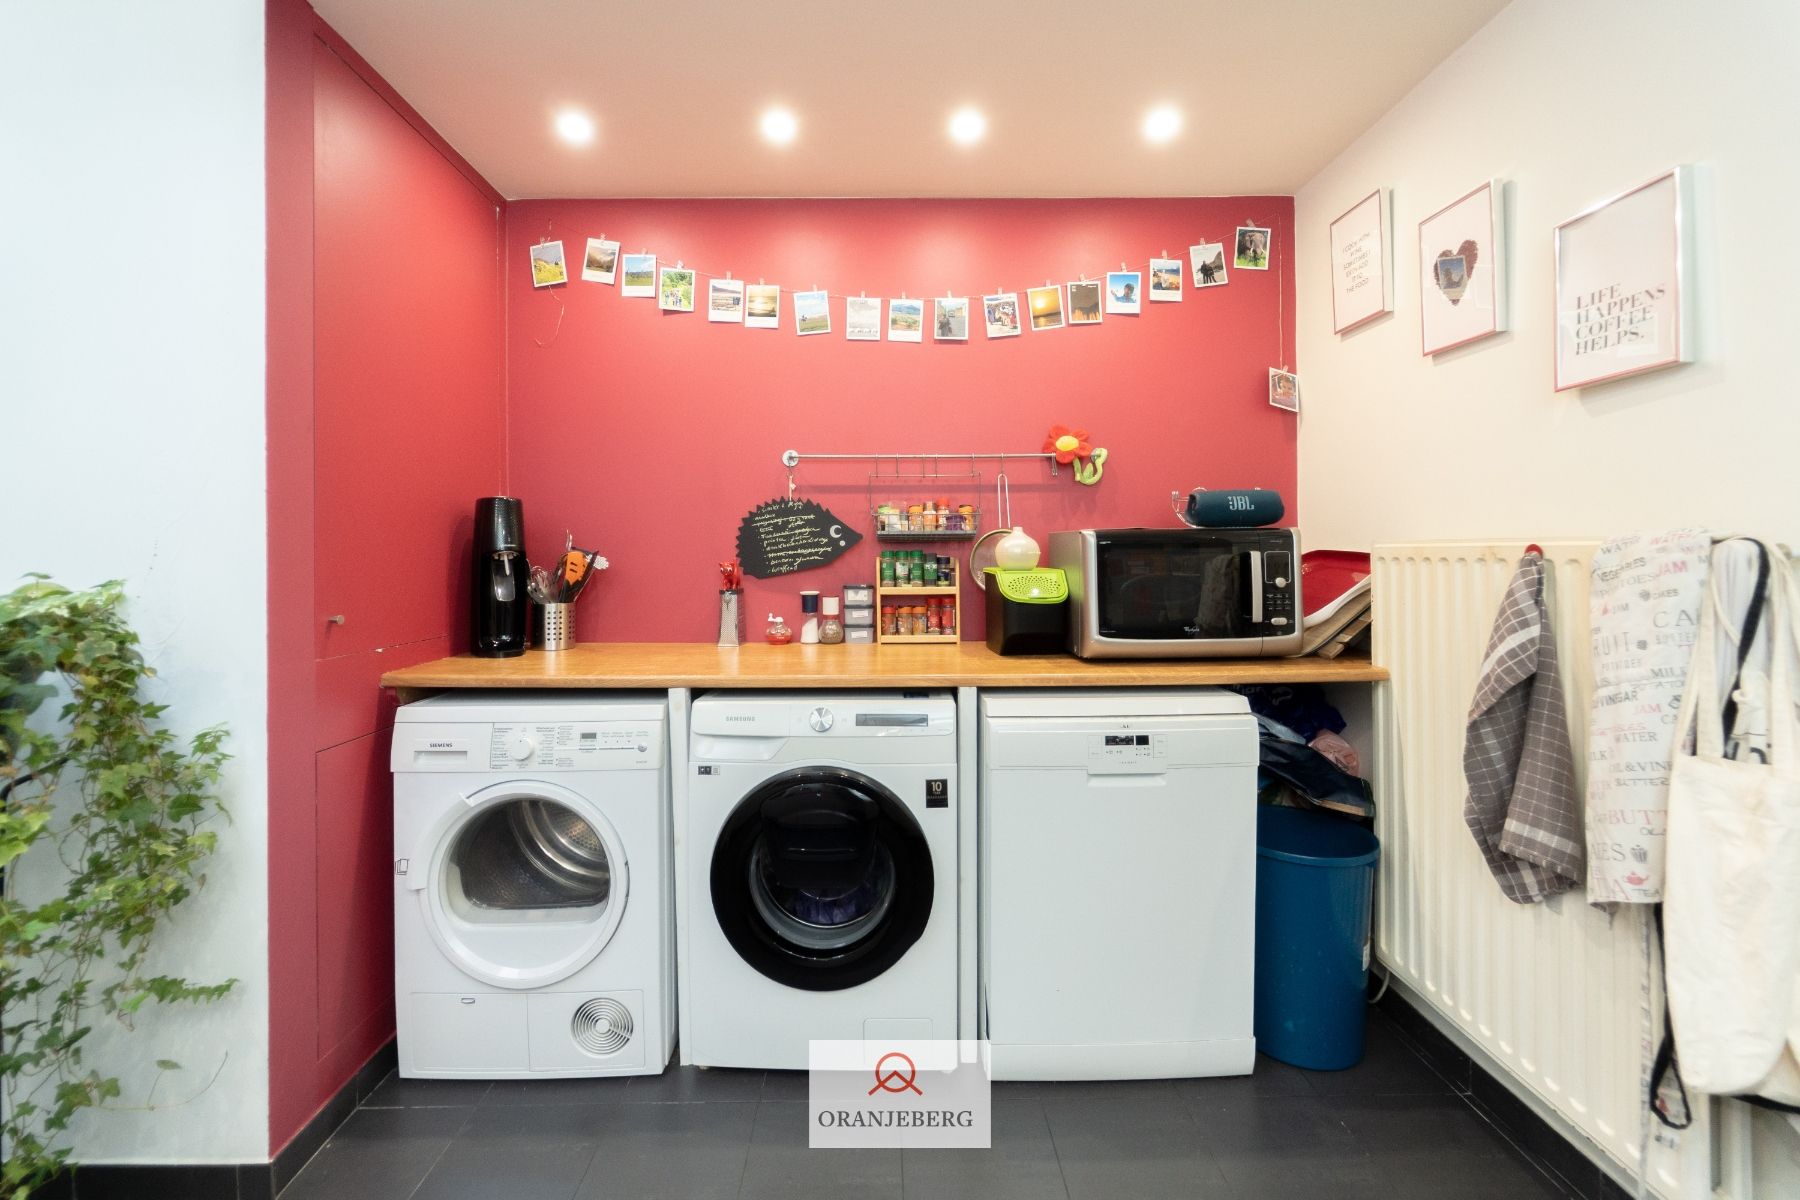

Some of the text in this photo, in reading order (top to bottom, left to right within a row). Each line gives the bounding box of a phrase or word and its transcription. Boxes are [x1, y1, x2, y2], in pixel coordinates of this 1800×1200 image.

[1576, 283, 1621, 310] LIFE
[1576, 283, 1666, 325] HAPPENS
[1576, 305, 1654, 340] COFFEE
[1575, 326, 1645, 356] HELPS.
[1227, 496, 1255, 511] JBL
[1656, 560, 1688, 577] JAM
[1614, 732, 1658, 744] WATER
[931, 781, 942, 792] 10
